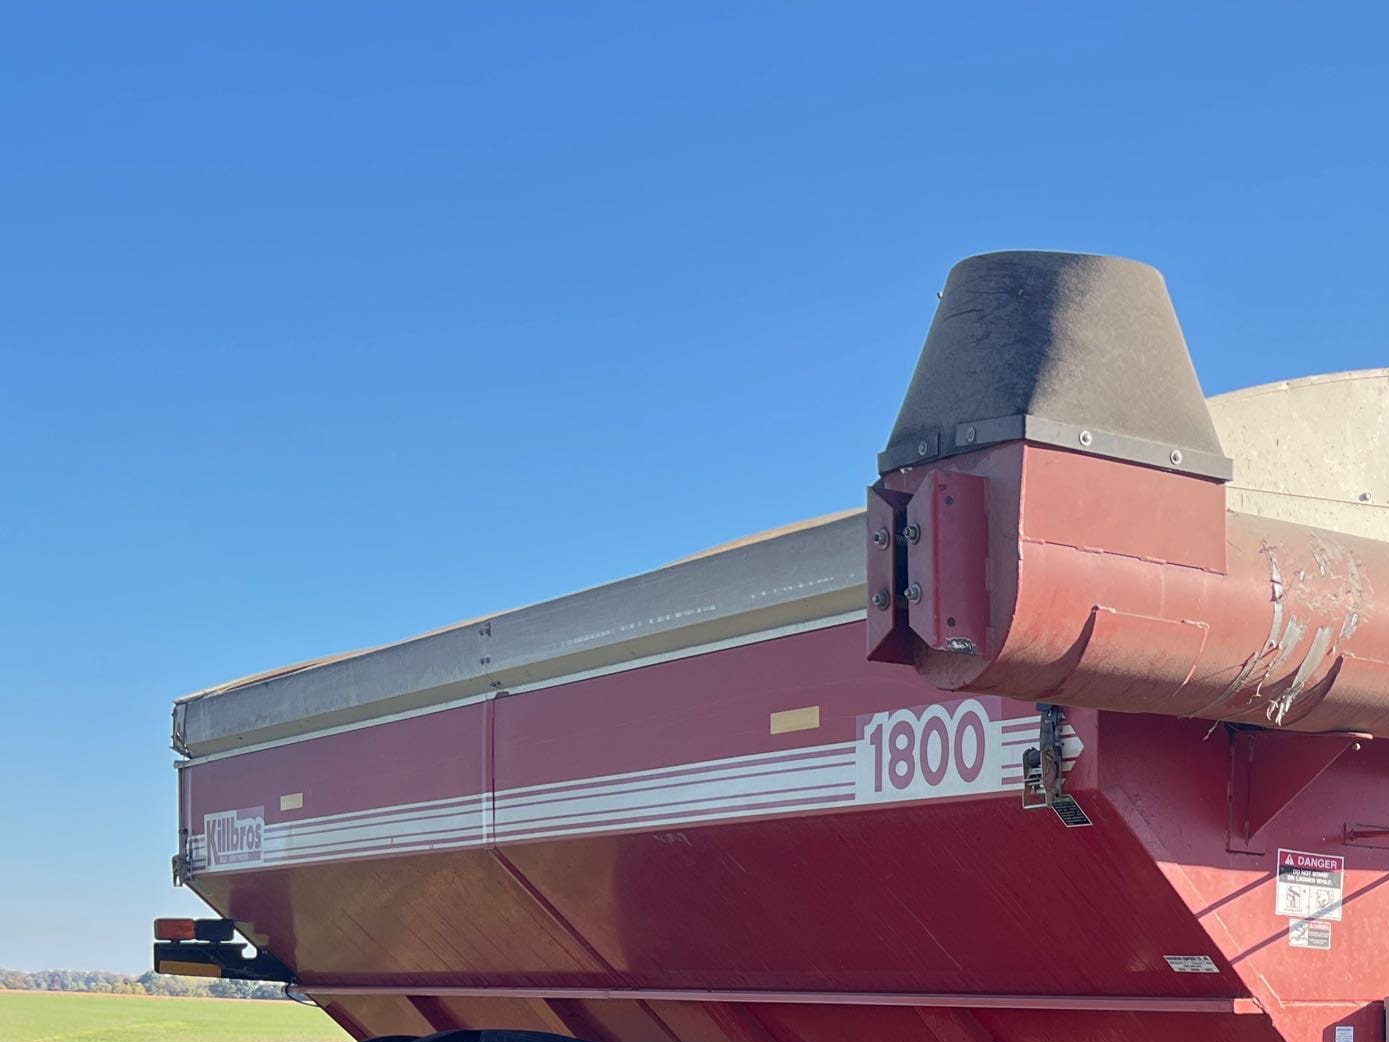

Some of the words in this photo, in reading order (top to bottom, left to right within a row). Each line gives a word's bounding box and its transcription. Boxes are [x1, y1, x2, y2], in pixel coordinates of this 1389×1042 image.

[869, 709, 986, 793] 1800
[206, 816, 262, 867] Killbros
[1297, 856, 1337, 869] DANGER
